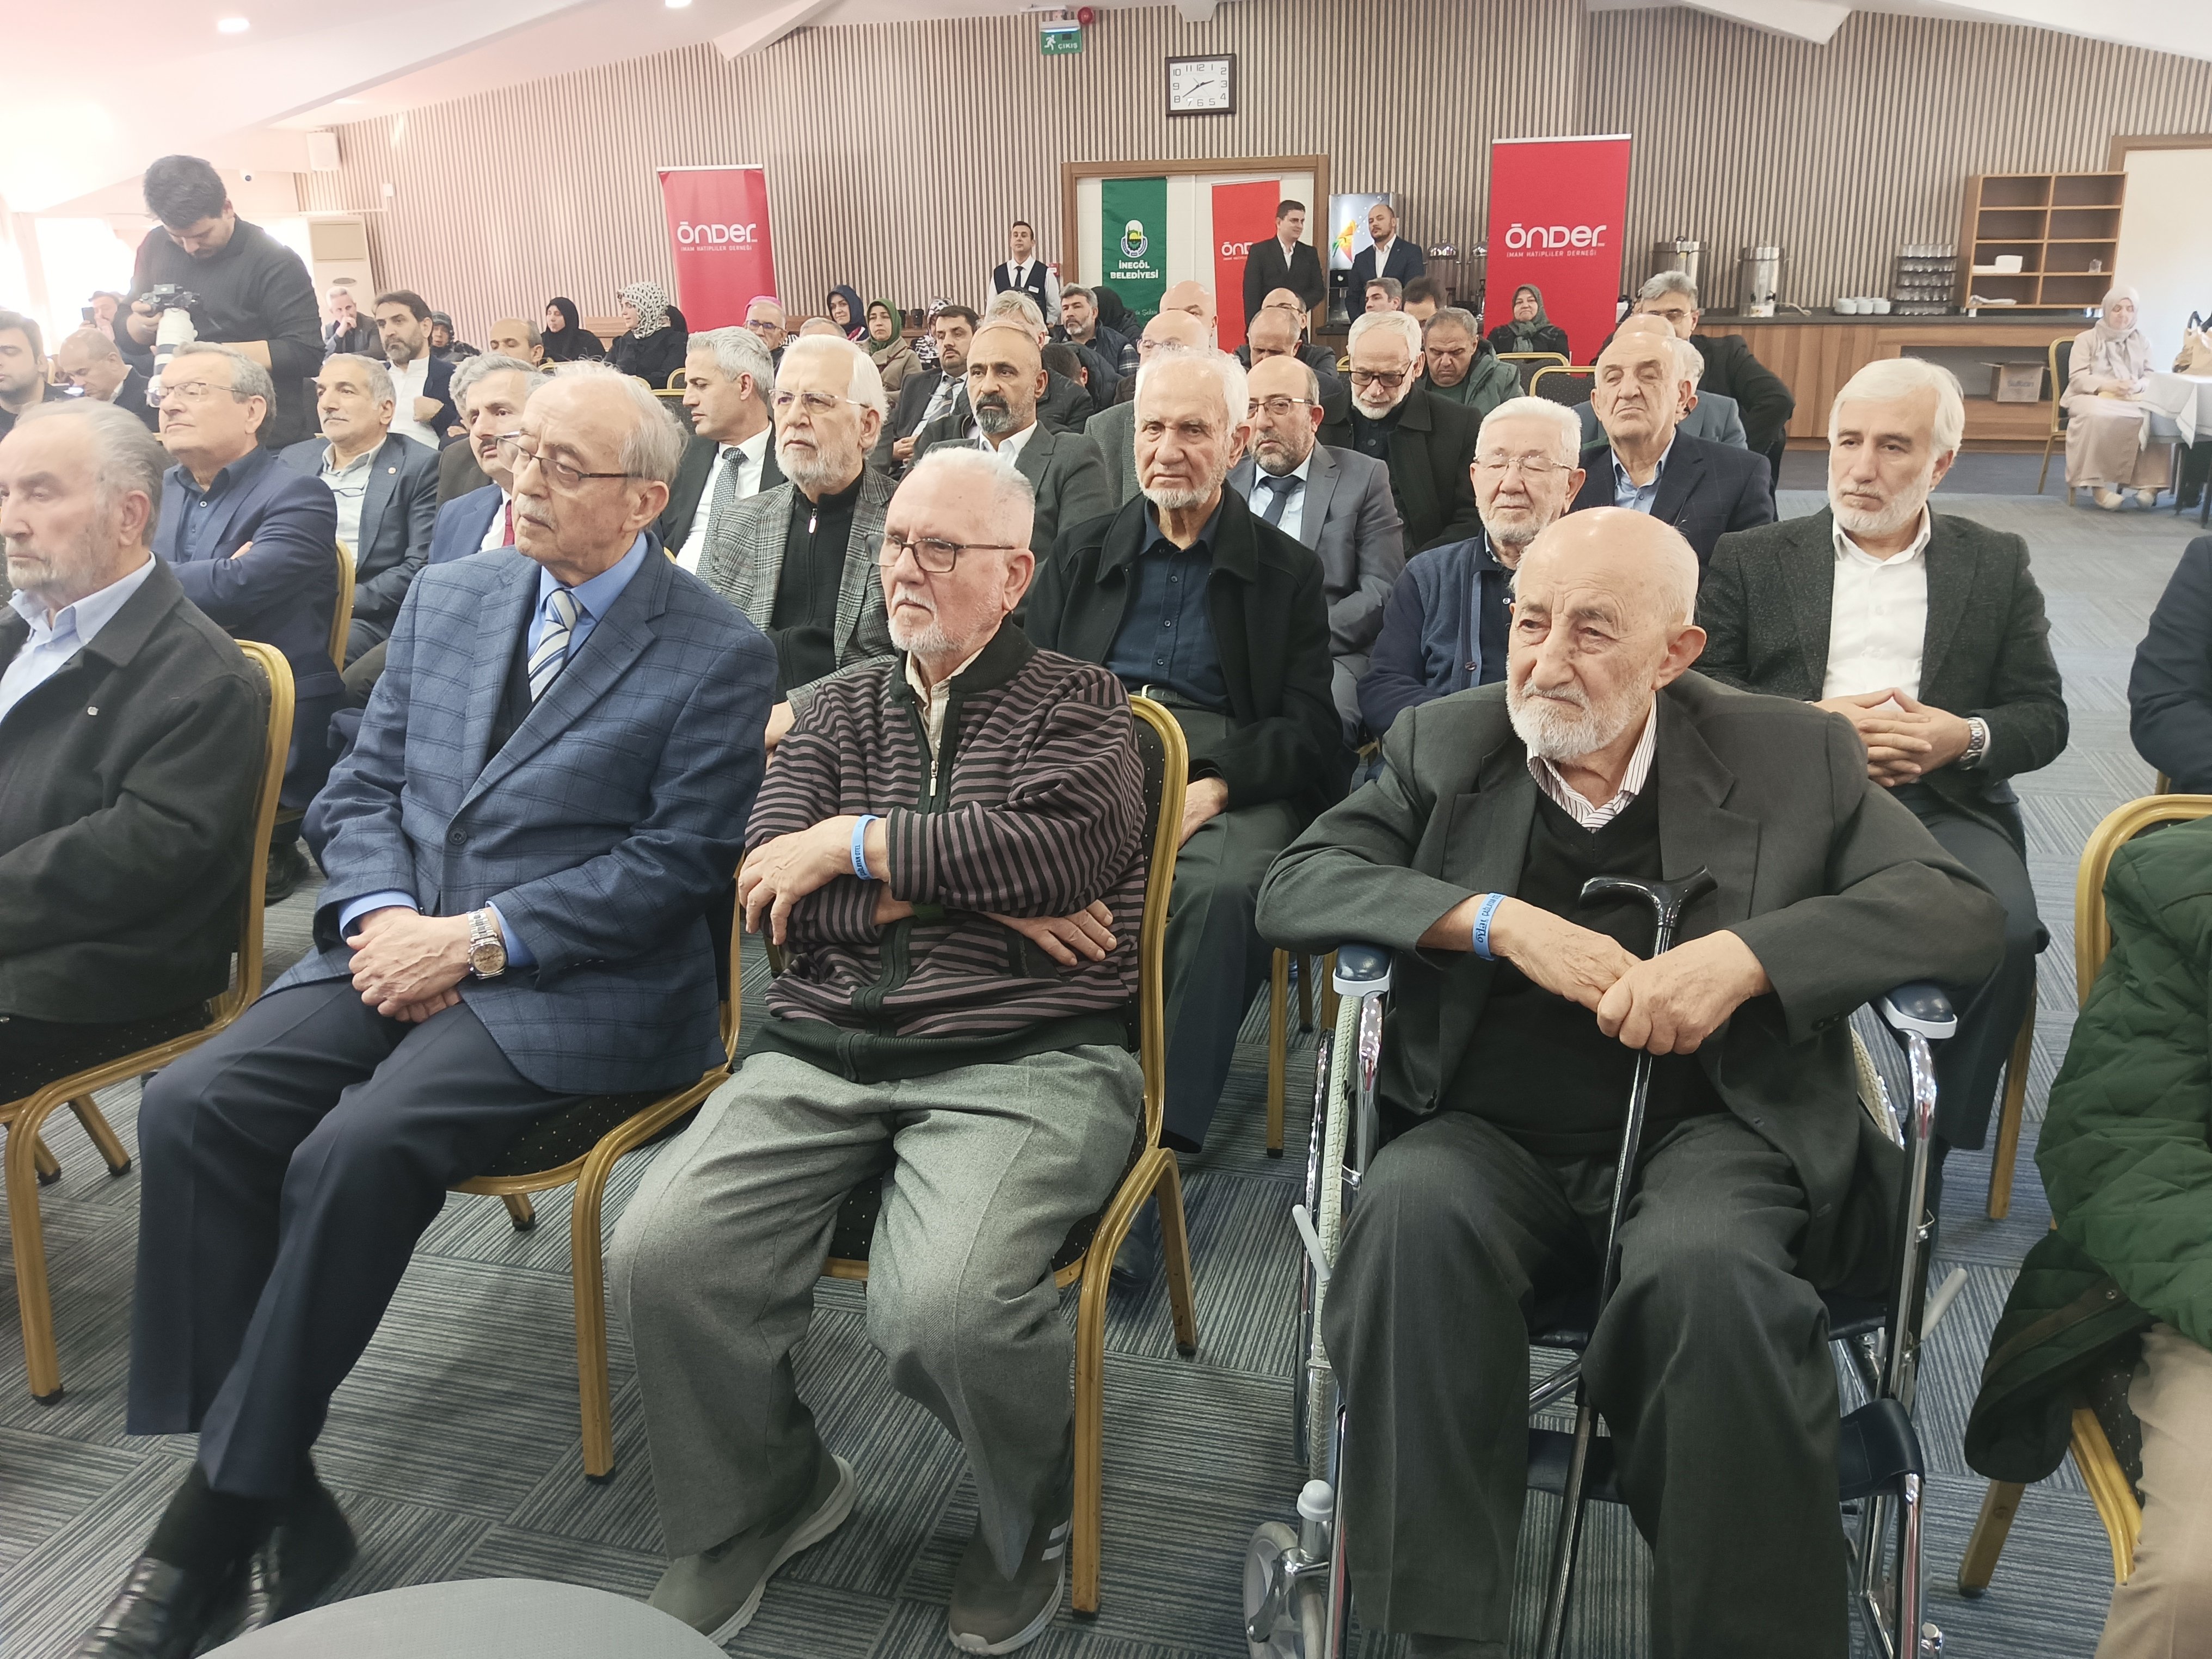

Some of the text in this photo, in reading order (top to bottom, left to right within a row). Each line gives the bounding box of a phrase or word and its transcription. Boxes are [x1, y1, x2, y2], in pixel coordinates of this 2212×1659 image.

[1220, 67, 1227, 75] 2
[1119, 260, 1150, 269] İNEGÖL
[1110, 269, 1158, 279] BELEDİYESİ
